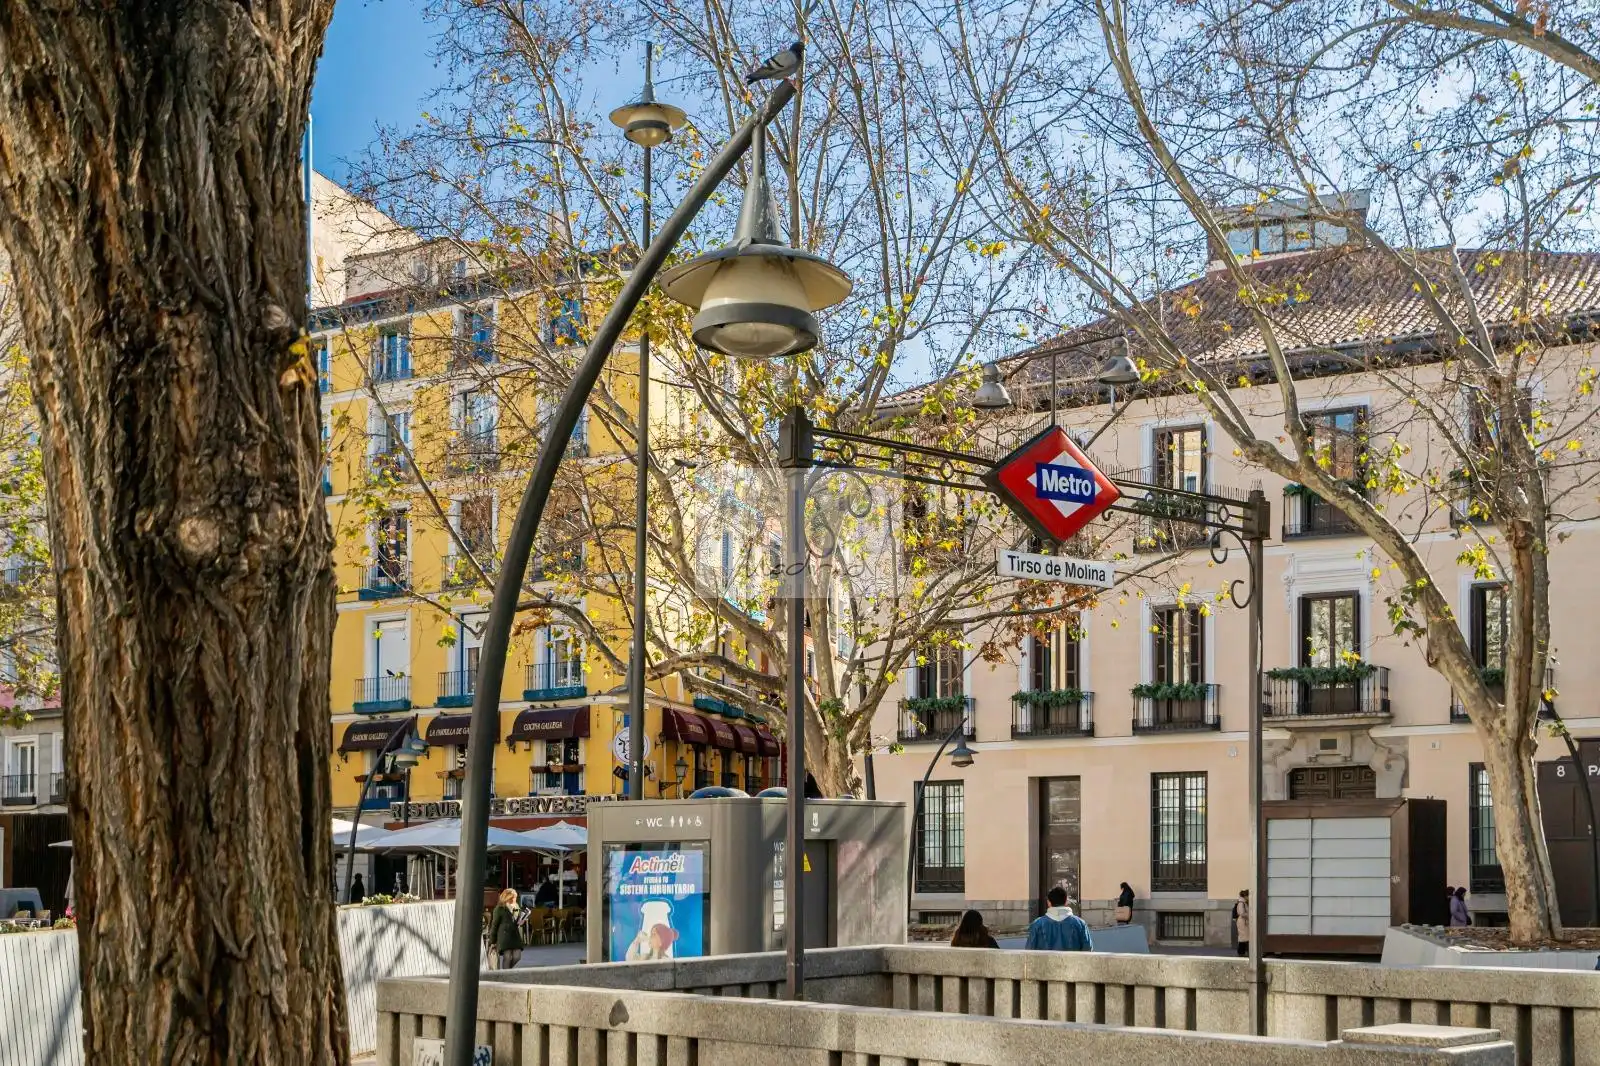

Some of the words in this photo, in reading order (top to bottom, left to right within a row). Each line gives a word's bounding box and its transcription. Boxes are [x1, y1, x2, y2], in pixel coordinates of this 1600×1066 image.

[1041, 468, 1093, 497] Metro
[1007, 554, 1041, 574] Tirso
[1045, 560, 1062, 577] de
[1065, 562, 1107, 582] Molina
[540, 721, 563, 730] GALLEGA
[1556, 765, 1566, 778] 8
[646, 817, 663, 828] WC
[773, 841, 785, 852] WC
[629, 854, 684, 873] Actimel
[619, 883, 649, 895] SISTEMA
